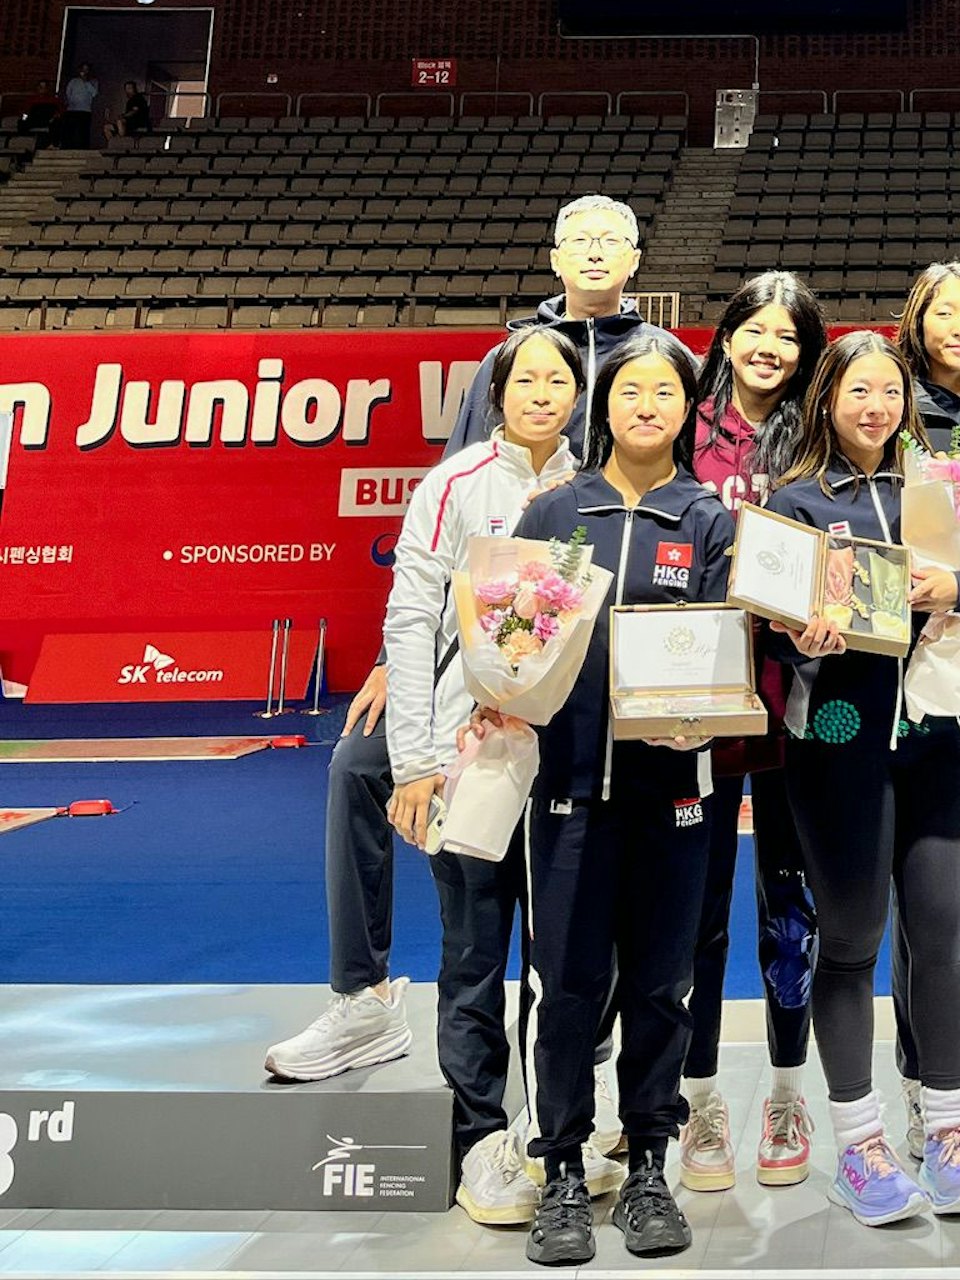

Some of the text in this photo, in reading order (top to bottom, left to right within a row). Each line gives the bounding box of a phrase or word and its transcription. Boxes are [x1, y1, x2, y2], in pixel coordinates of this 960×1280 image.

[418, 70, 450, 83] 2-12
[75, 357, 392, 450] Junior
[180, 543, 337, 563] SPONSORED BY
[653, 564, 690, 581] HKG
[117, 665, 224, 684] SK telecom
[675, 804, 704, 820] HKG
[323, 1164, 376, 1196] FIE
